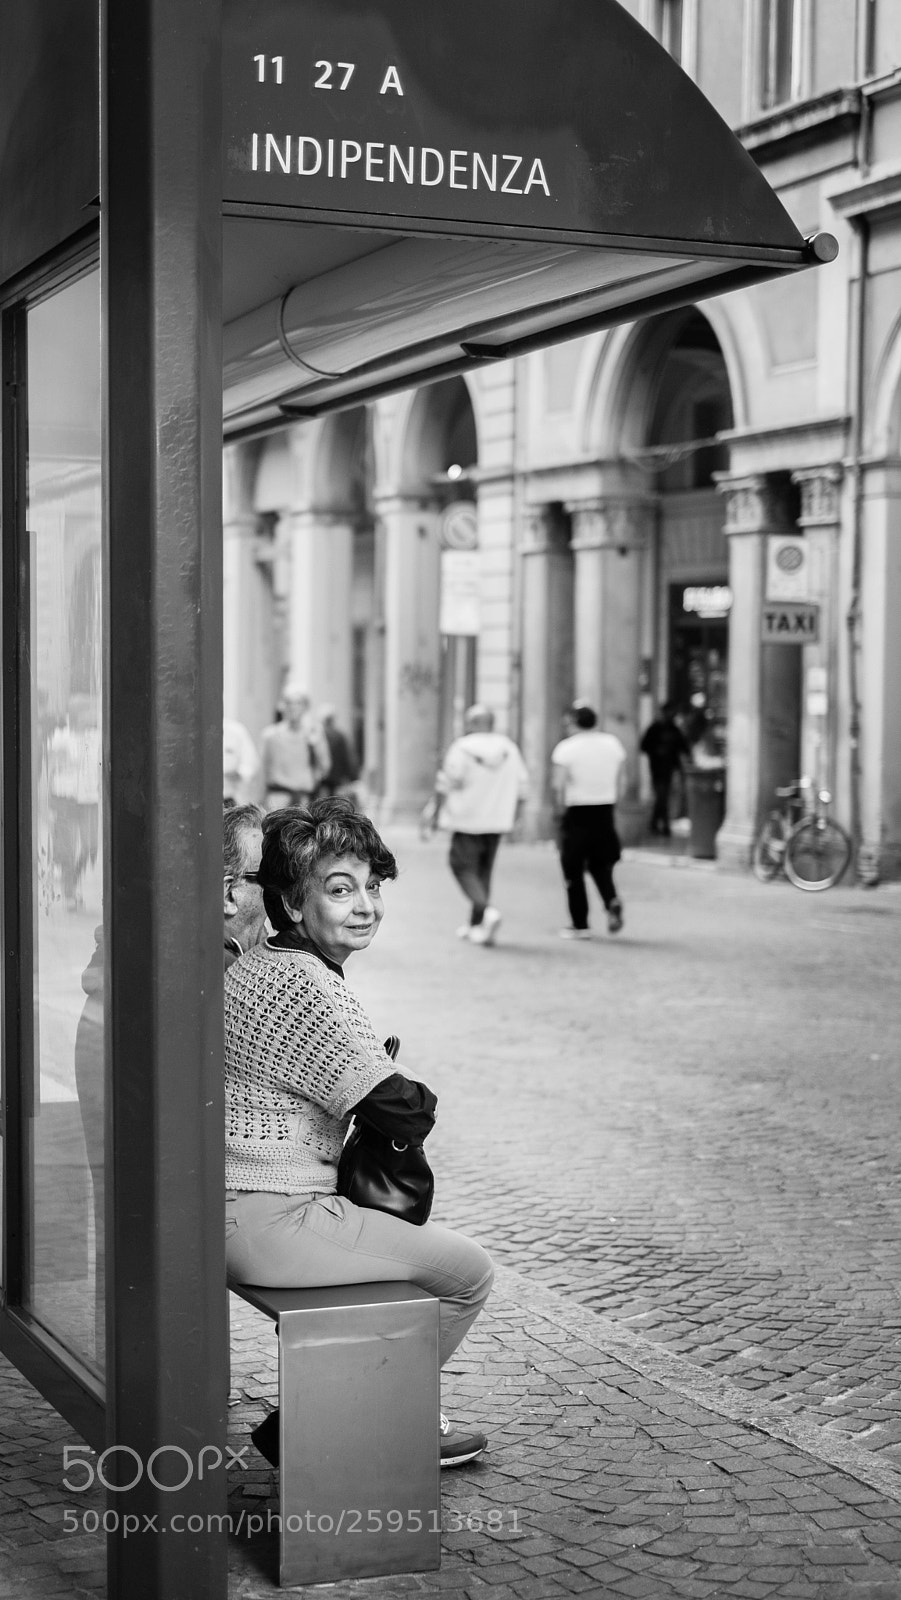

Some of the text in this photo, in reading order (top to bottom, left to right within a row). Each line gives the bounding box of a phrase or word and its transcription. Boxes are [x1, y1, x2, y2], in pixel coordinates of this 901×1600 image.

[253, 54, 404, 96] 11 27 A
[251, 132, 551, 197] INDIPENDENZA
[765, 611, 815, 633] TAXI
